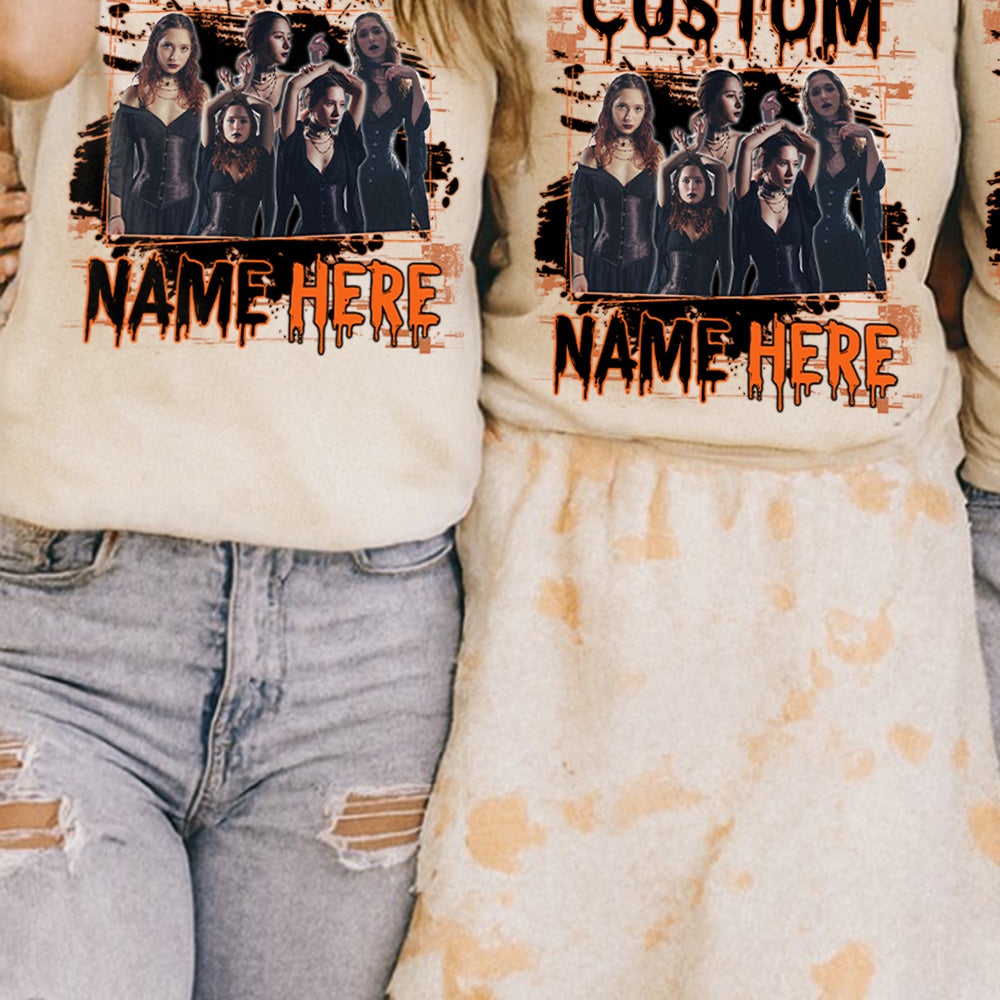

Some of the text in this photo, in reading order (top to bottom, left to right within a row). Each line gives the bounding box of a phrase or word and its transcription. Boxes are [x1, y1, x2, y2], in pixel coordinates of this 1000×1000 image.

[83, 252, 443, 356] NAME HERE
[552, 311, 901, 413] NAME HERE
